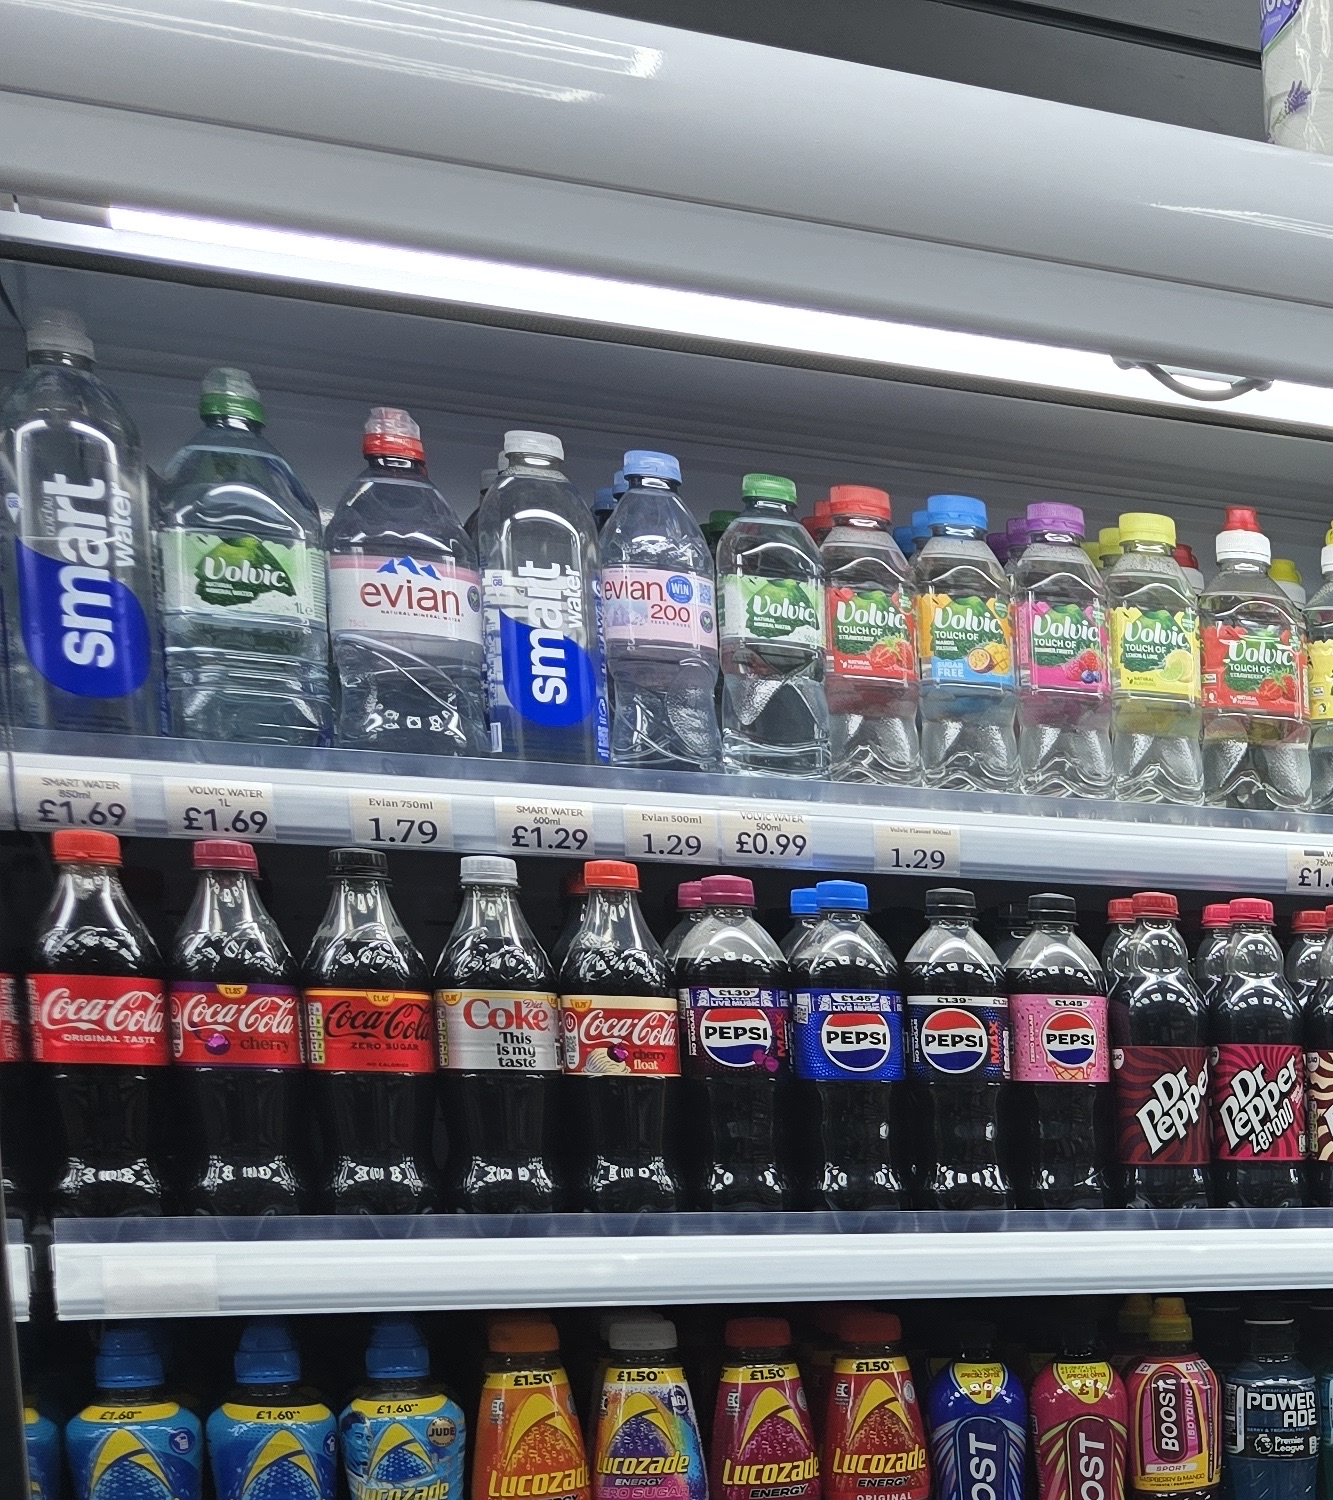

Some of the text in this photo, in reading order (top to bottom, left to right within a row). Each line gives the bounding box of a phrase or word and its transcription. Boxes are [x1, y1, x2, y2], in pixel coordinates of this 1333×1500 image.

[109, 484, 133, 566] water
[44, 474, 114, 668] smart
[204, 556, 289, 588] Volvic
[360, 579, 462, 616] evian
[837, 603, 905, 628] Volvic
[934, 607, 1001, 633] Volvic
[838, 625, 883, 636] TOUCH OF
[41, 777, 120, 791] SMART WATER
[188, 786, 263, 799] VOLVIC WATER
[369, 798, 433, 811] Evian 750ml
[516, 805, 583, 818] SMART WATER
[38, 800, 127, 828] £1.69
[182, 808, 268, 835] £1.69
[533, 816, 562, 826] 600ml
[641, 812, 702, 824] Evian 500ml
[741, 812, 804, 823] VOLVIC WATER
[370, 818, 438, 845] 1.79
[756, 823, 781, 831] 500ml
[512, 824, 589, 852] £1.29
[642, 832, 701, 858] 1.29
[736, 833, 807, 857] £0.99
[891, 848, 946, 870] 1.29
[43, 989, 164, 1032] Coca-Cola
[525, 999, 543, 1010] Diet
[184, 995, 295, 1033] Coca-Cola
[464, 999, 550, 1031] Coke
[63, 1033, 155, 1044] ORIGINAL TASTE
[500, 1033, 532, 1045] This
[704, 1023, 770, 1043] PEPSI
[925, 1033, 984, 1051] PEPSI
[1046, 1032, 1094, 1048] PEPSI
[241, 1036, 289, 1054] cherry
[350, 1041, 419, 1052] ZERO SUGAR
[497, 1045, 535, 1060] is my
[498, 1056, 536, 1068] taste
[1246, 1392, 1316, 1411] POWER
[1284, 1411, 1317, 1426] ADE
[428, 1425, 455, 1437] JUDE
[1274, 1437, 1304, 1446] Premier
[1274, 1443, 1304, 1452] League
[833, 1449, 926, 1473] Lucozade
